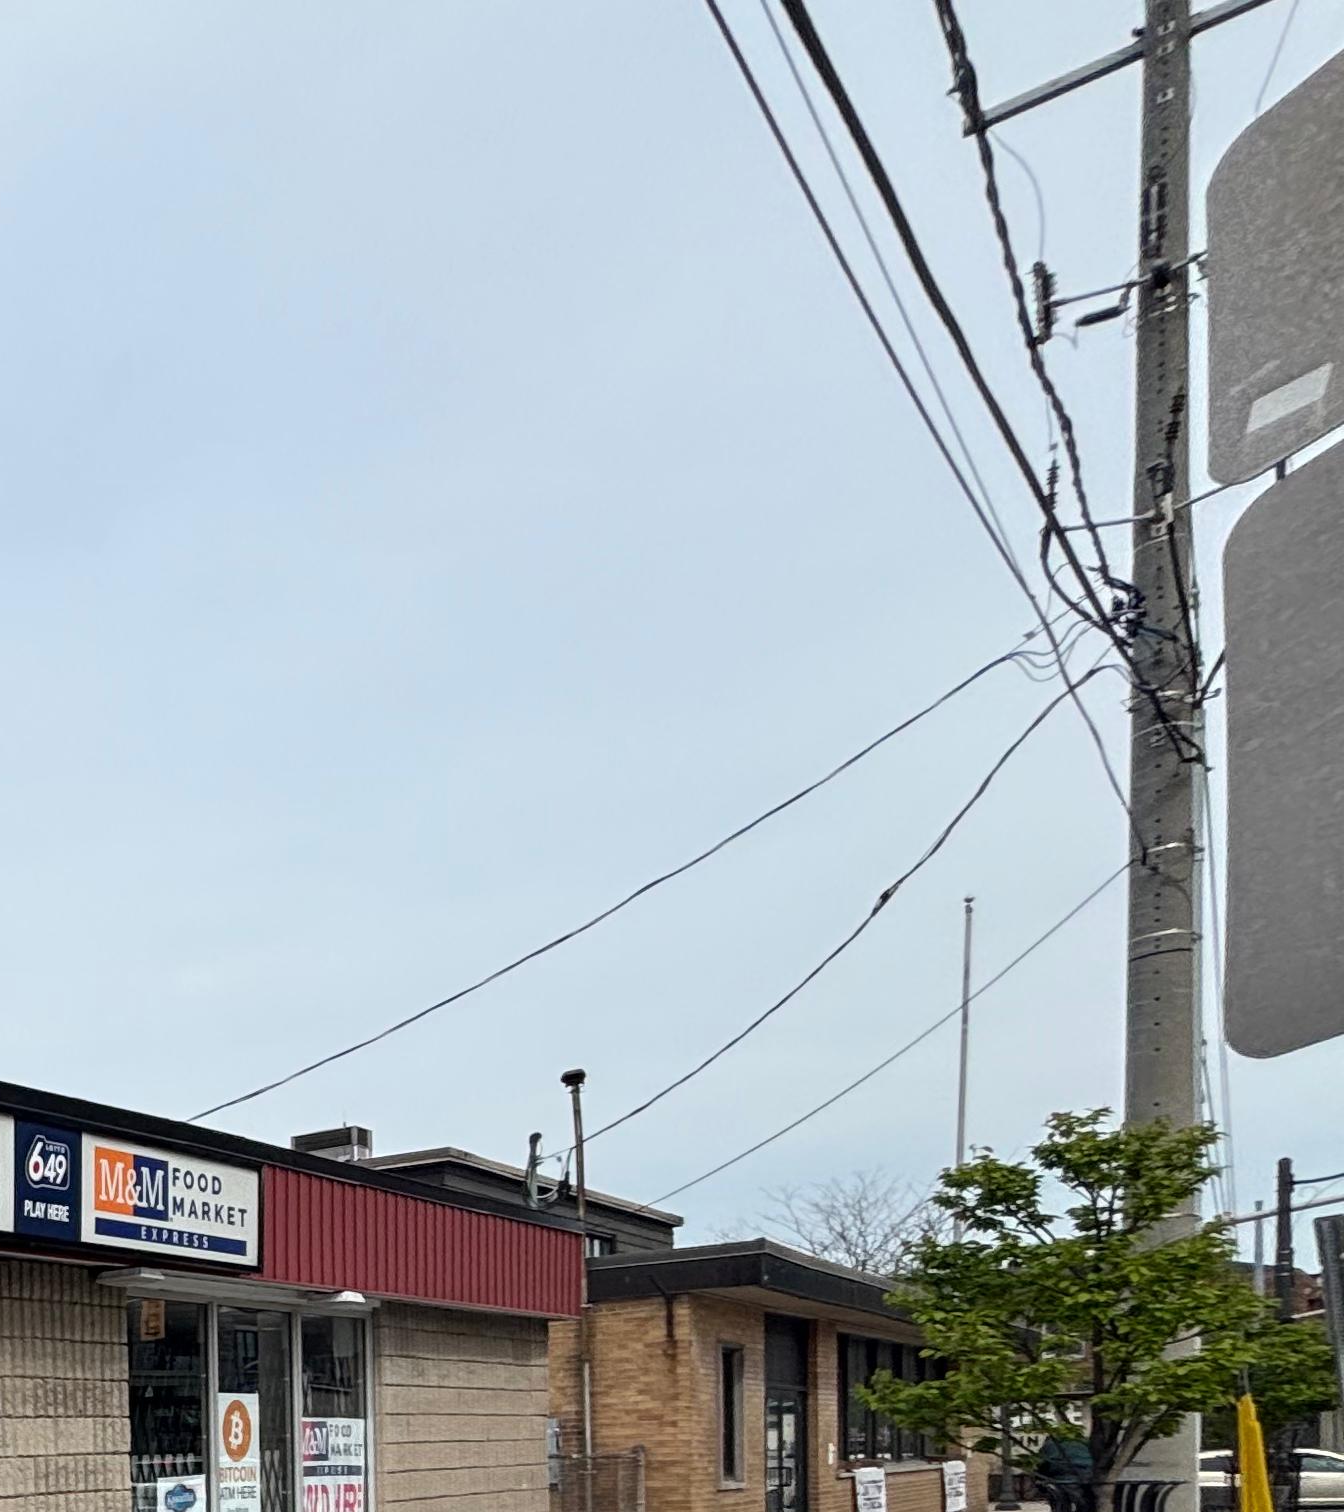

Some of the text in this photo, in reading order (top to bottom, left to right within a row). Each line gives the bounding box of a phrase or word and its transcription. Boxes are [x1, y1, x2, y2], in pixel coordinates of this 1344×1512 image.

[99, 1157, 166, 1211] M&M
[172, 1167, 222, 1195] FOOD
[24, 1199, 69, 1222] PLAY HERE
[172, 1196, 247, 1227] MARKET
[141, 1226, 209, 1249] EXPRESS
[216, 1466, 257, 1483] BITCOIN
